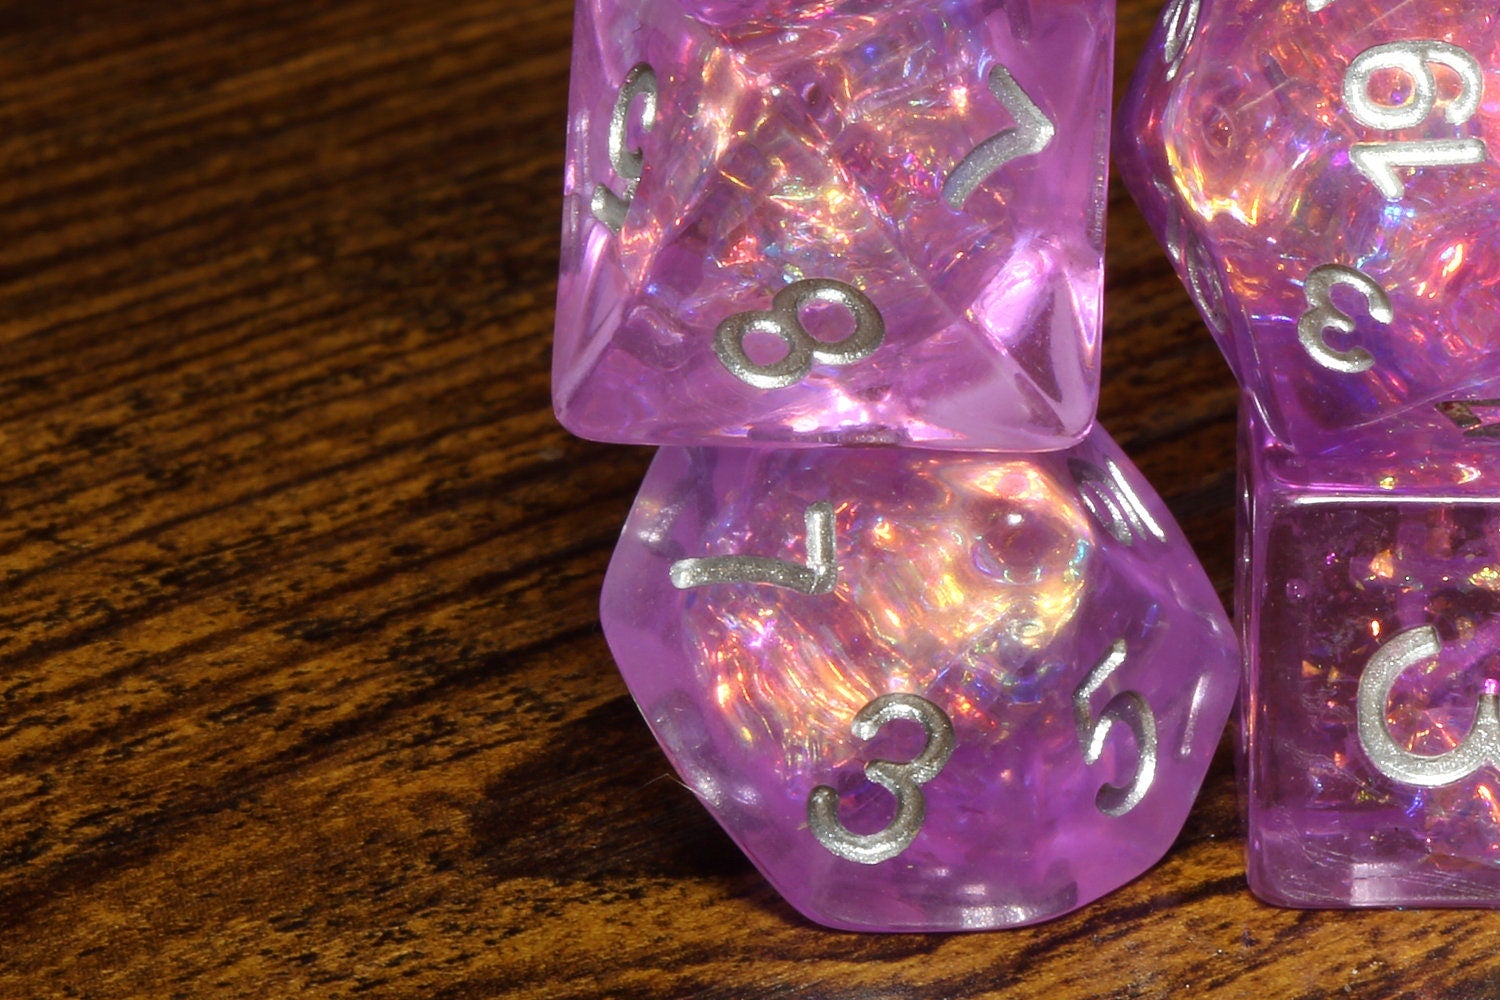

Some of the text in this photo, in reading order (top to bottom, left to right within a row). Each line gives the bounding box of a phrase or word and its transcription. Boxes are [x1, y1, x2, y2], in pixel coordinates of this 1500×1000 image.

[943, 64, 1055, 212] 7
[1342, 40, 1487, 202] 19
[714, 278, 886, 389] 8
[1298, 262, 1394, 374] 3
[669, 501, 837, 595] 7
[808, 692, 956, 864] 3
[1072, 639, 1157, 817] 5
